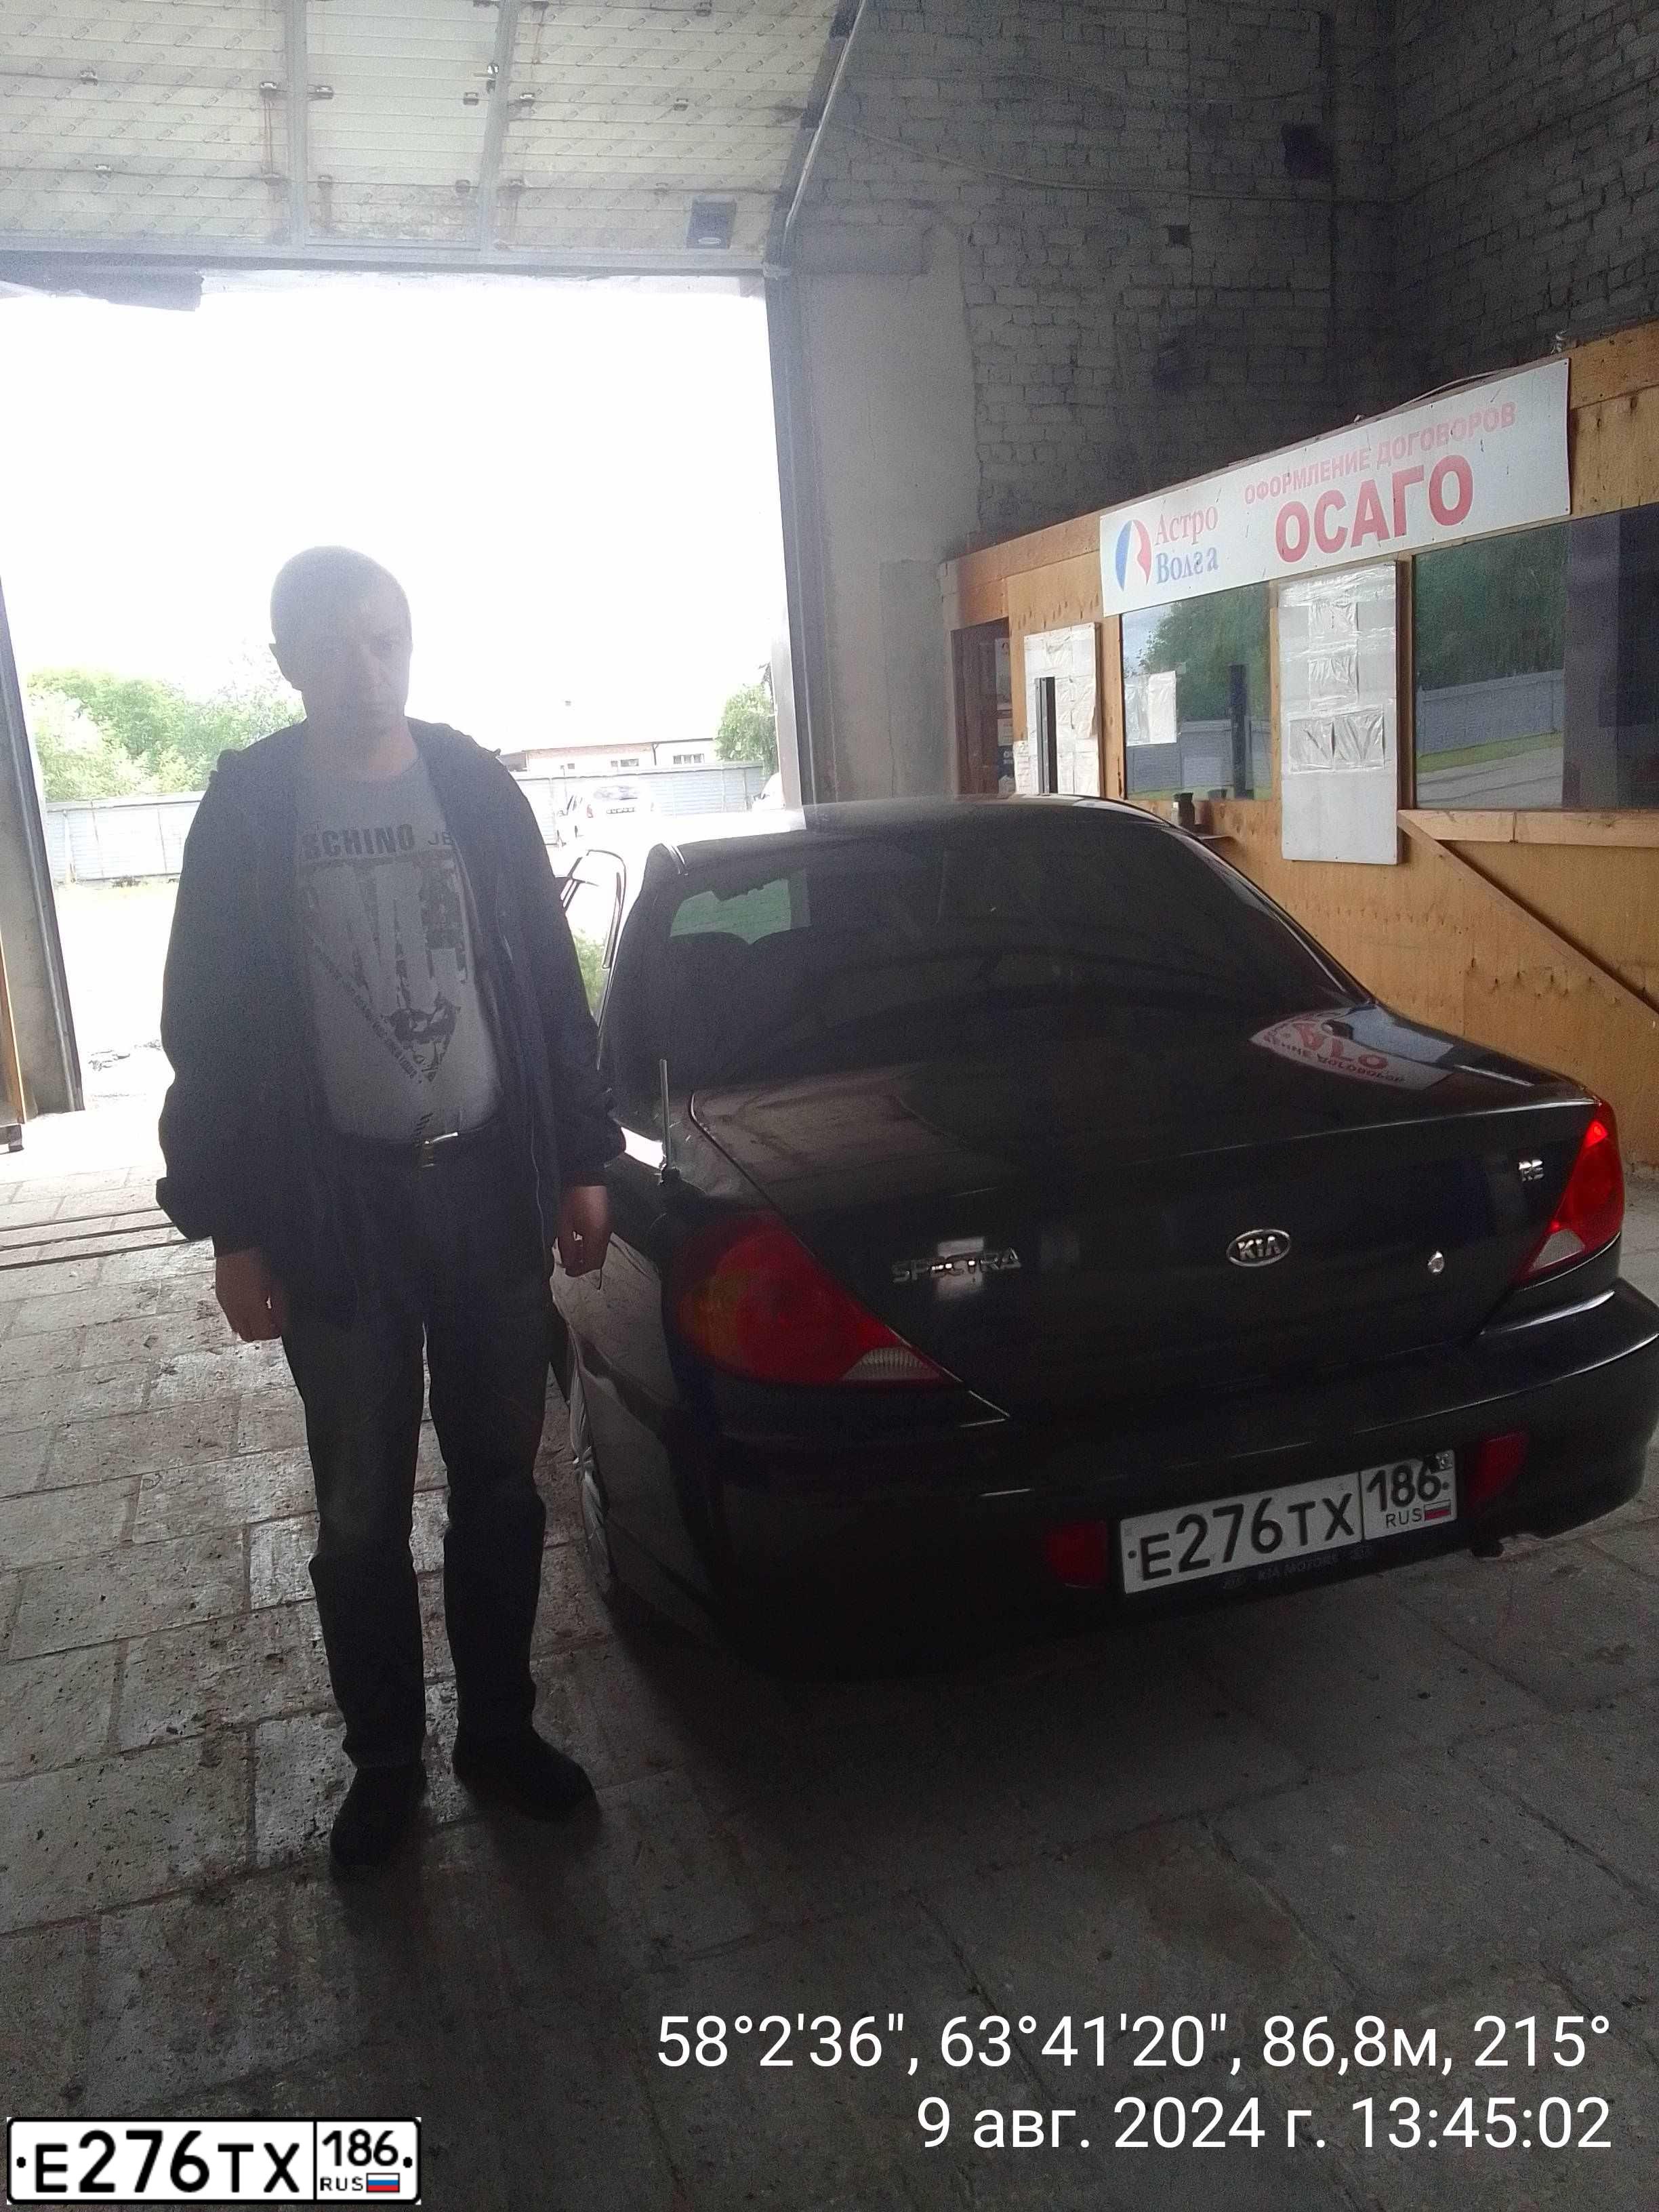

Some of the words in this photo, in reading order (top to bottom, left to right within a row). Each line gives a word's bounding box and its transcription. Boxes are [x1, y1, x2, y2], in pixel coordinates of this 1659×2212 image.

[1245, 449, 1370, 504] ОФОРМЛЕНИЕ
[1377, 401, 1516, 468] ДОГОВОРОВ
[1155, 506, 1218, 546] Астро
[1276, 454, 1473, 562] ОСАГО
[1155, 547, 1219, 584] Волга
[1238, 1235, 1282, 1262] KIA
[1366, 1464, 1442, 1513] 186
[1385, 1510, 1422, 1529] RUS
